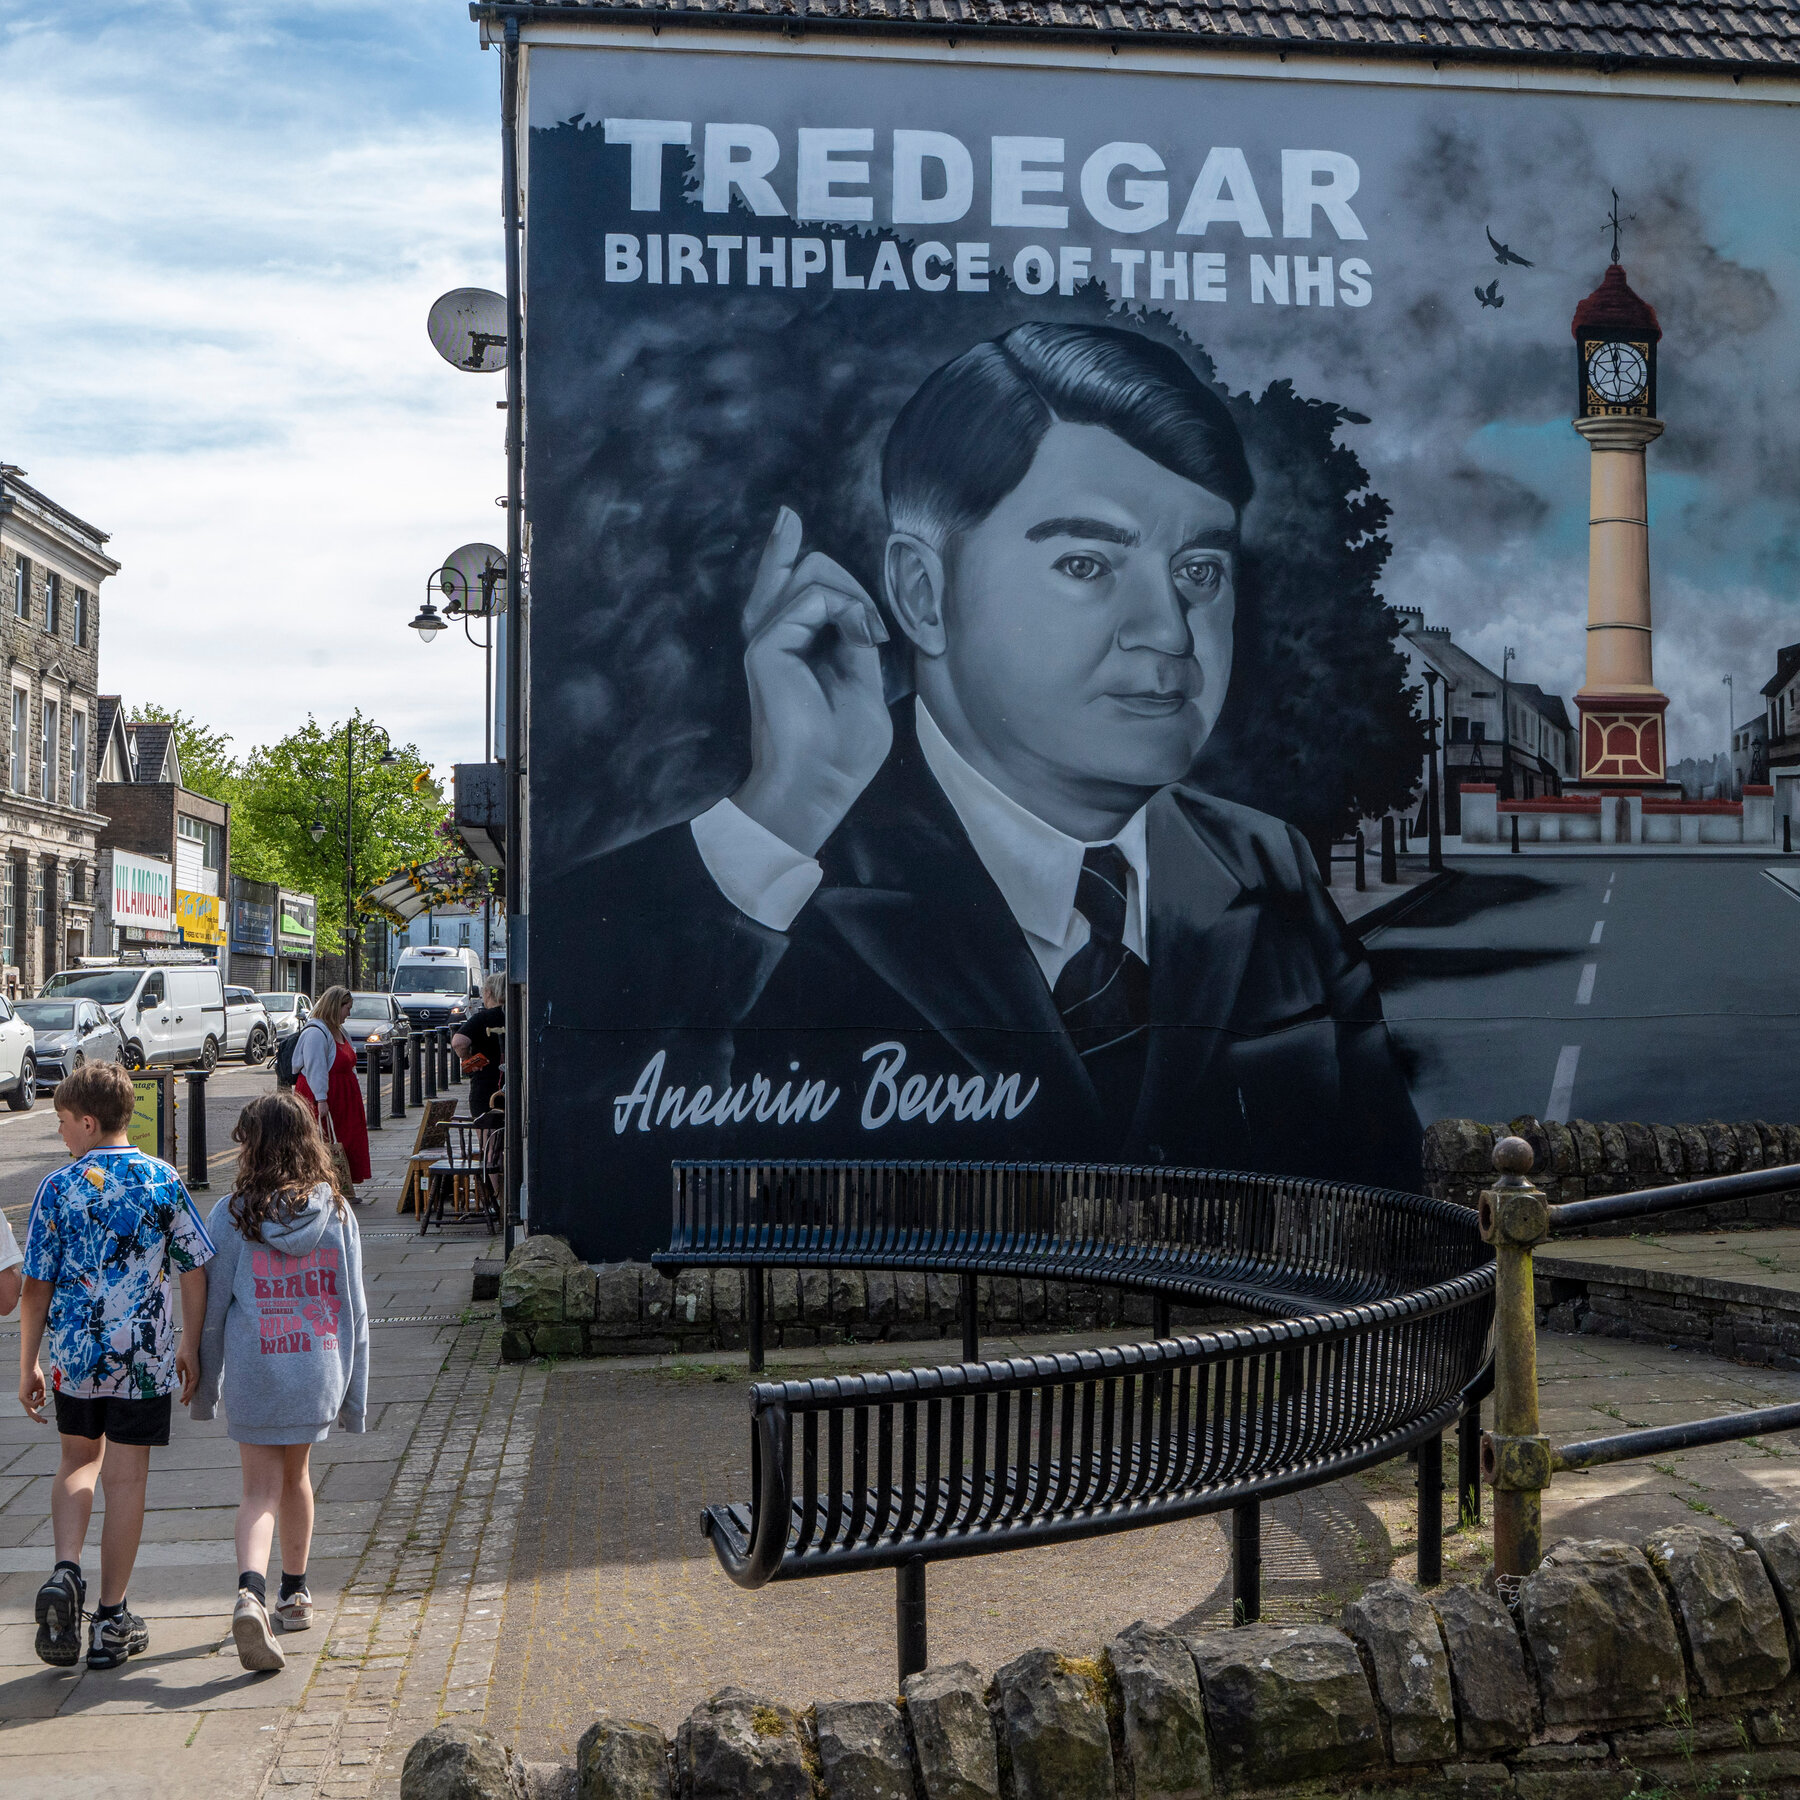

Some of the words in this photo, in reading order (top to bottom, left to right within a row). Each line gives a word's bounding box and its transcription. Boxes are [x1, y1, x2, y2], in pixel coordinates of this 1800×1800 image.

[604, 118, 1368, 240] TREDEGAR
[605, 233, 990, 292] BIRTHPLACE
[1013, 245, 1091, 296] OF
[1111, 249, 1227, 302] THE
[1250, 254, 1373, 307] NHS
[115, 864, 169, 919] VILAMOURA
[133, 1082, 156, 1090] ntage
[613, 1050, 840, 1134] Aneurin
[860, 1041, 1040, 1130] Bevan
[133, 1110, 154, 1121] urniture
[253, 1269, 338, 1298] BEACH
[259, 1316, 302, 1338] WILD
[260, 1332, 312, 1355] WAVE
